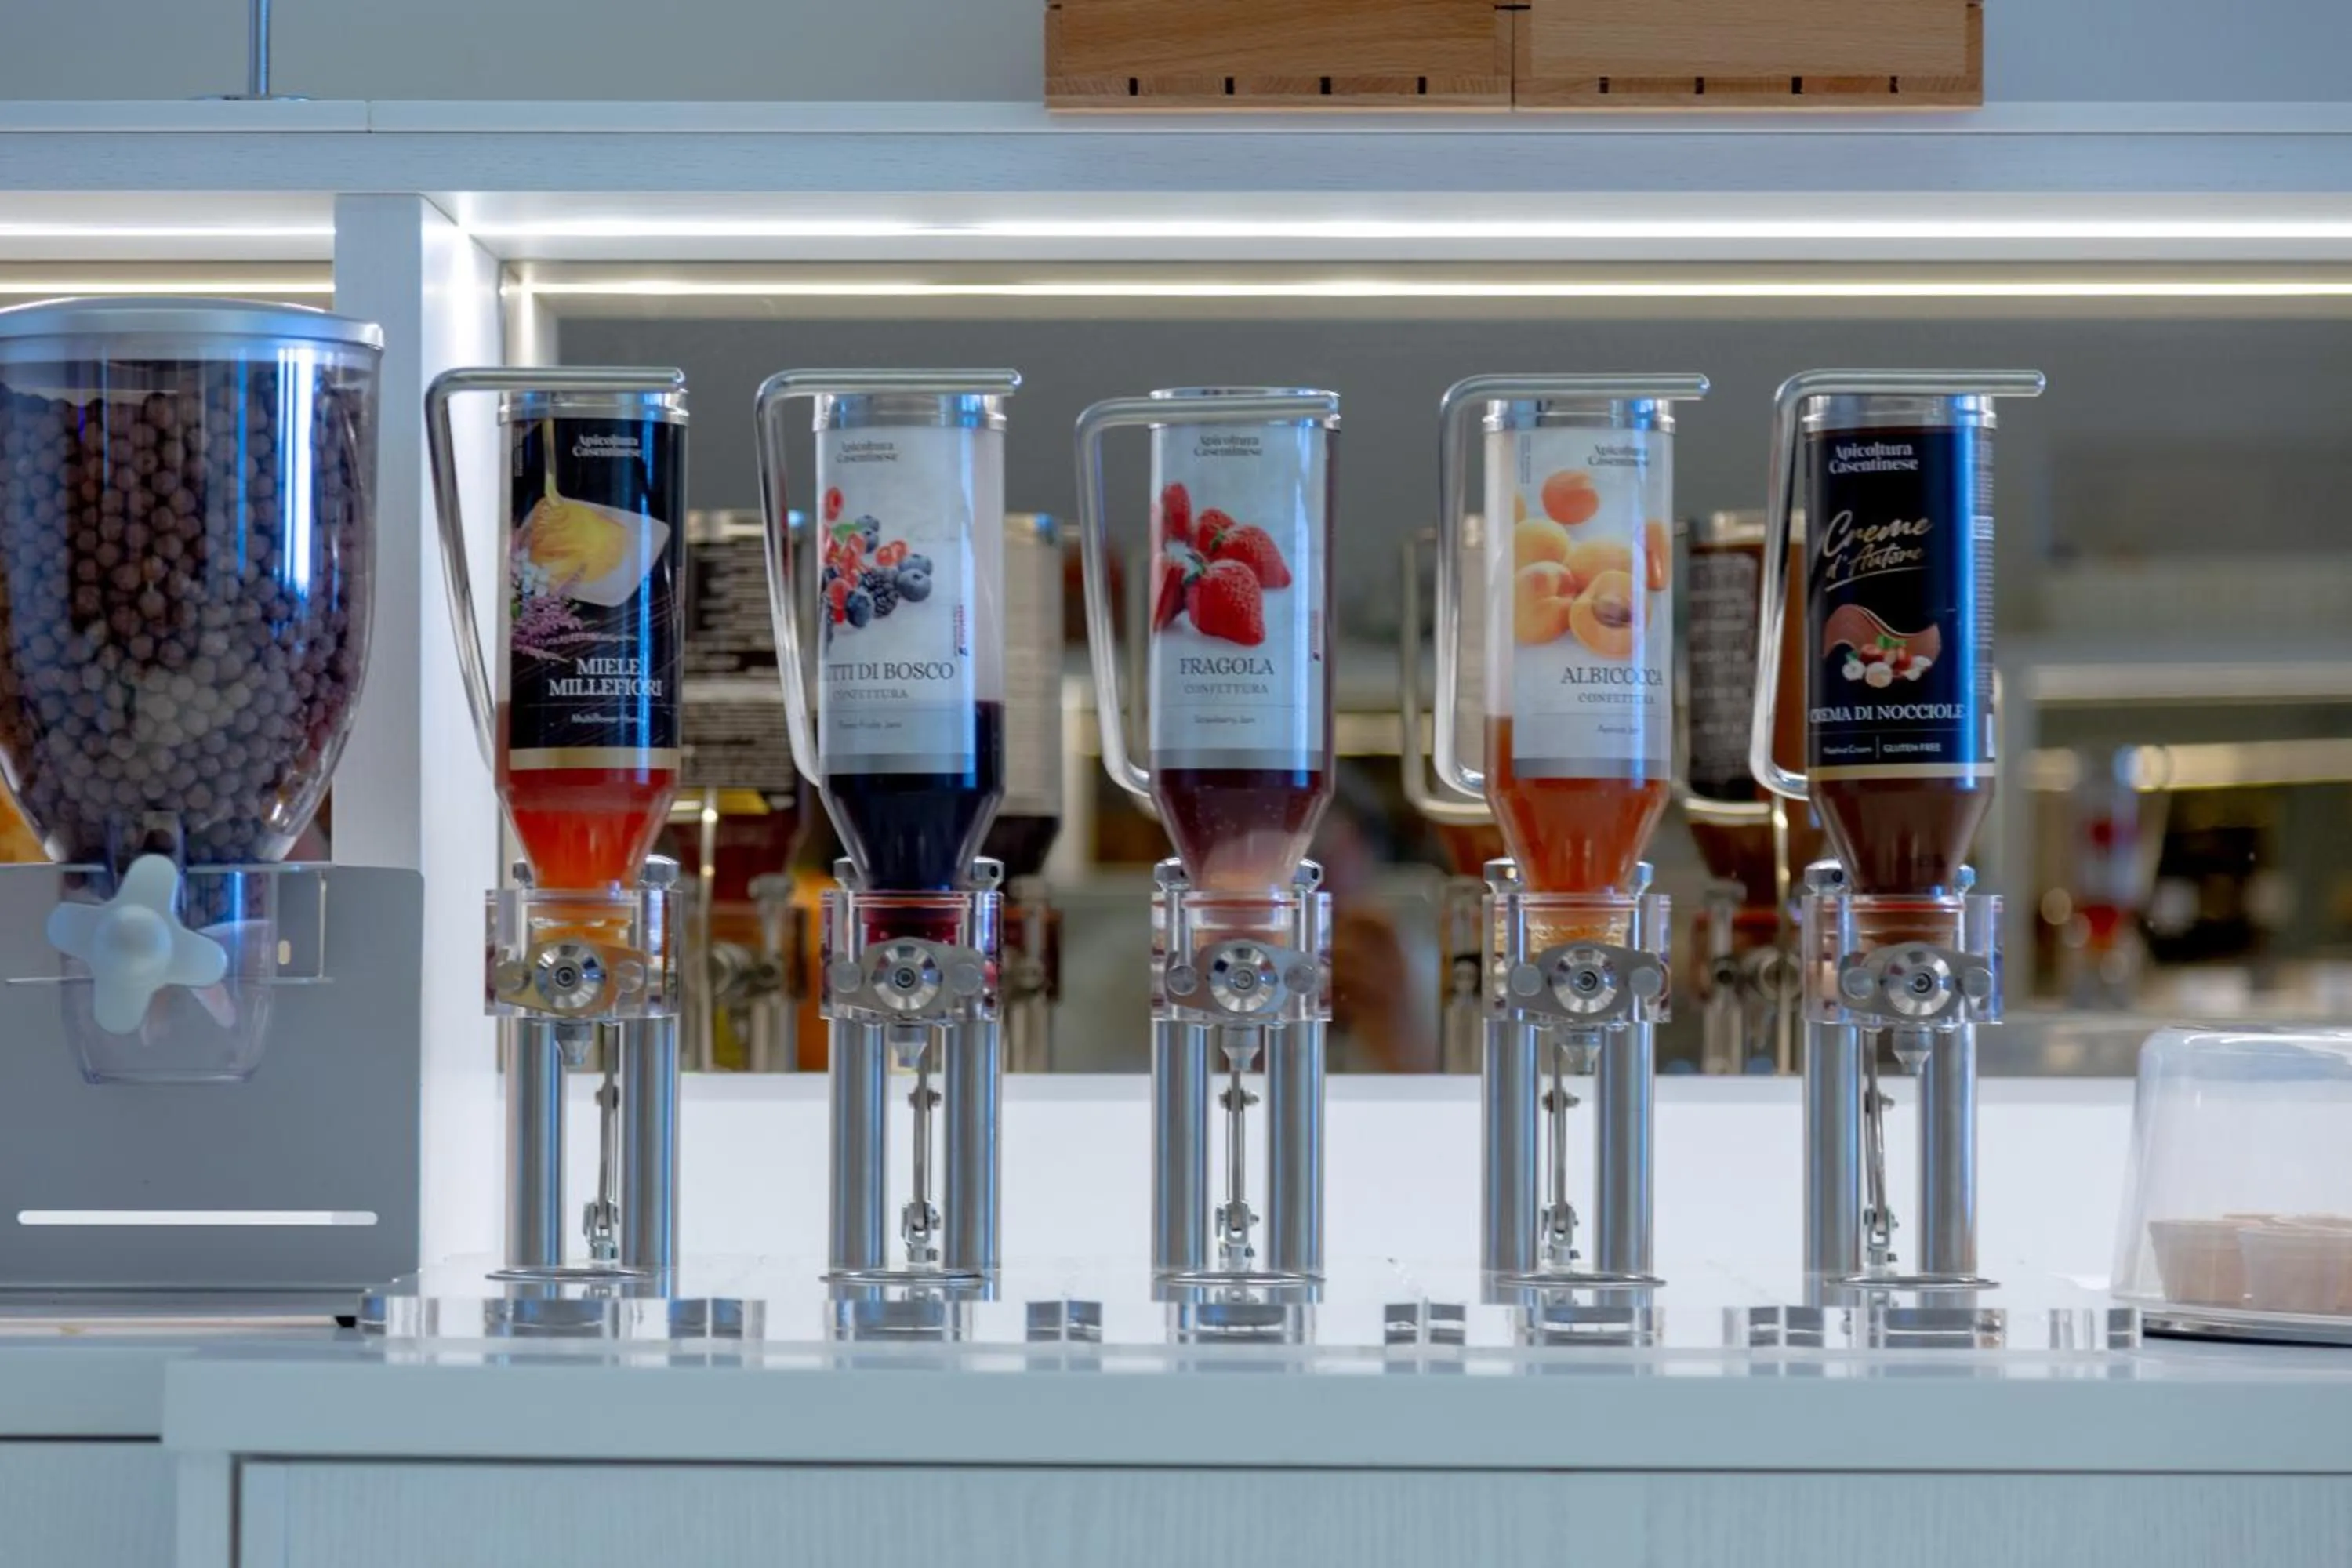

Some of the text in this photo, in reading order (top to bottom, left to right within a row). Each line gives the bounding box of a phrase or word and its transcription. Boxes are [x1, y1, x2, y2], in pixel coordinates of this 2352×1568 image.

[1835, 441, 1913, 459] Apicoltura
[1828, 457, 1918, 474] Casentinese
[1823, 510, 1935, 557] Creme
[576, 658, 641, 675] MIELE
[858, 662, 879, 681] DI
[884, 662, 954, 681] BOSCO
[1179, 658, 1275, 676] FRAGOLA
[1560, 667, 1664, 686] ALBICOCCA
[549, 678, 662, 696] MILLEFIORI
[1854, 706, 1873, 720] DI
[1877, 704, 1965, 720] NOCCIOLE
